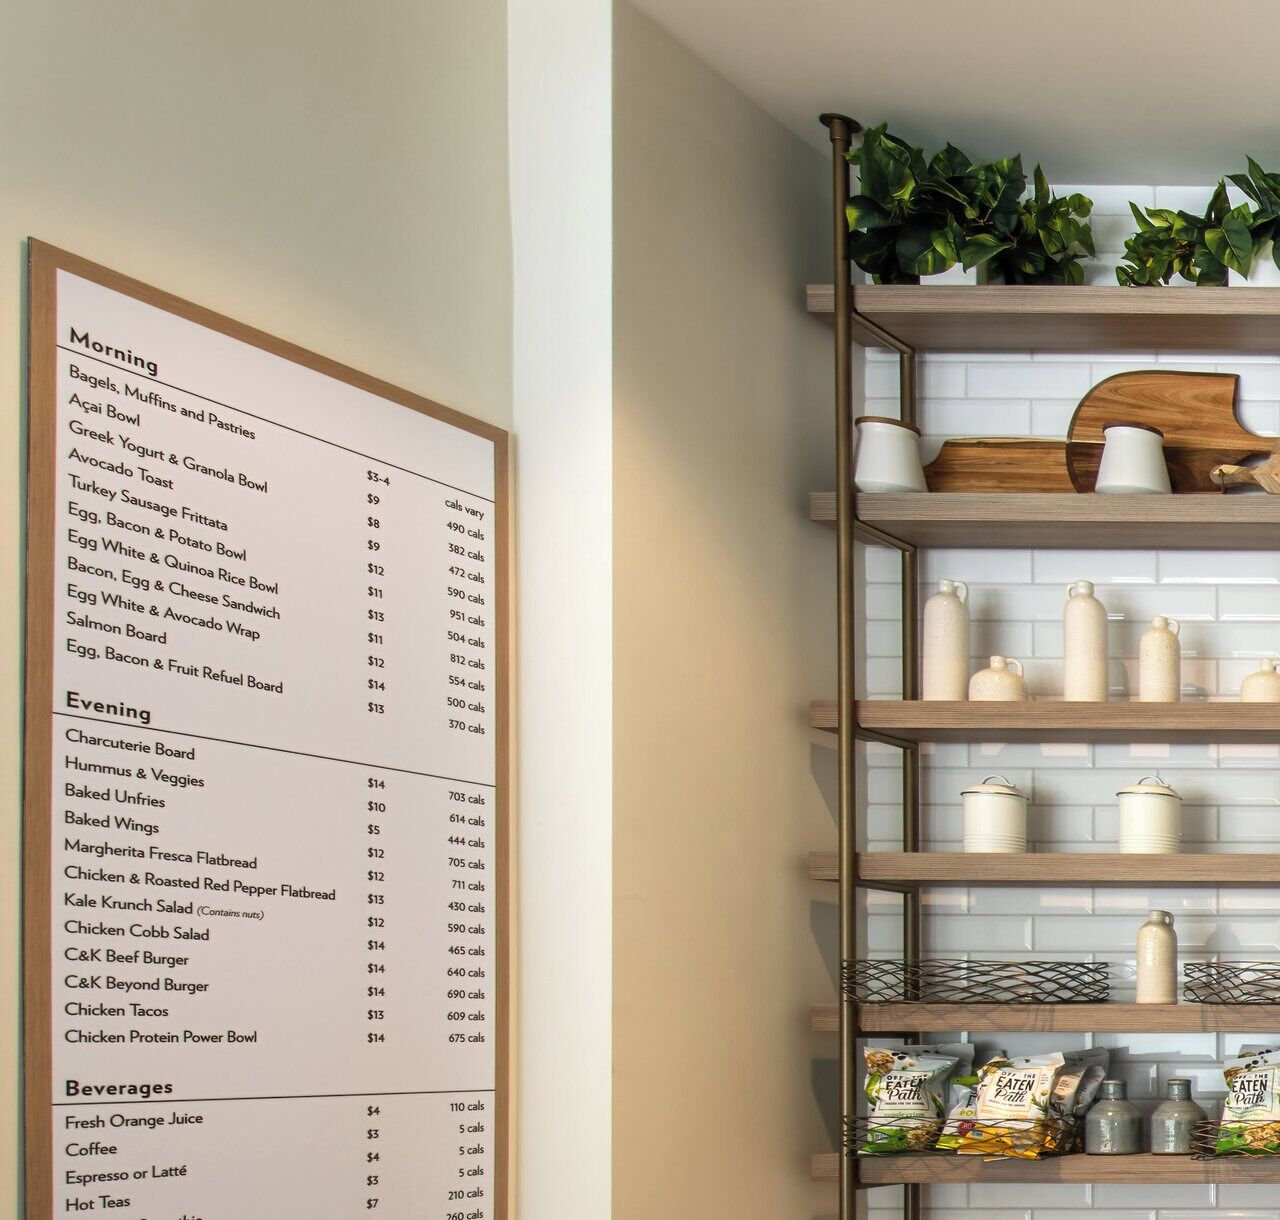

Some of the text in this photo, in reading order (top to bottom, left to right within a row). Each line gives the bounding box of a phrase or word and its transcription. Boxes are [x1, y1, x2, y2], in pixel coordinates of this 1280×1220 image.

[69, 326, 158, 377] Morning
[68, 419, 268, 494] Greek Yogurt & Granola Bowl
[367, 516, 380, 529] $8
[447, 542, 485, 562] 382 cals
[67, 555, 281, 620] Bacon, Egg & Cheese Sandwich
[65, 610, 167, 645] Salmon Board
[367, 631, 383, 645] $11
[449, 652, 485, 670] 812 cals
[367, 678, 386, 691] $14
[66, 690, 151, 725] Evening
[446, 696, 485, 713] 500 cals
[64, 727, 195, 761] Charcuterie Board
[367, 777, 386, 789] $14
[448, 790, 485, 806] 703 cals
[63, 864, 336, 901] Chicken & Roasted Red Pepper Flatbread
[367, 892, 384, 905] $13
[447, 901, 485, 913] 430 cals
[64, 974, 210, 995] C&K Beyond Burger
[367, 985, 385, 997] $14
[446, 988, 485, 1000] 690 cals
[64, 1028, 257, 1043] Chicken Protein Power Bowl
[366, 1032, 385, 1044] $14
[448, 1031, 485, 1043] 675 cals
[65, 1079, 173, 1099] Beverages
[998, 1076, 1036, 1091] EATEN
[1232, 1080, 1268, 1093] EATEN
[886, 1087, 922, 1101] Path
[995, 1086, 1027, 1104] Path
[1234, 1091, 1265, 1106] Path
[366, 1104, 381, 1117] $4
[449, 1099, 485, 1112] 110 cals
[64, 1111, 204, 1130] Fresh Orange Juice
[458, 1142, 485, 1156] 5 cals
[366, 1151, 380, 1163] $4
[65, 1164, 188, 1187] Espresso or Latté
[465, 1207, 484, 1220] cals
